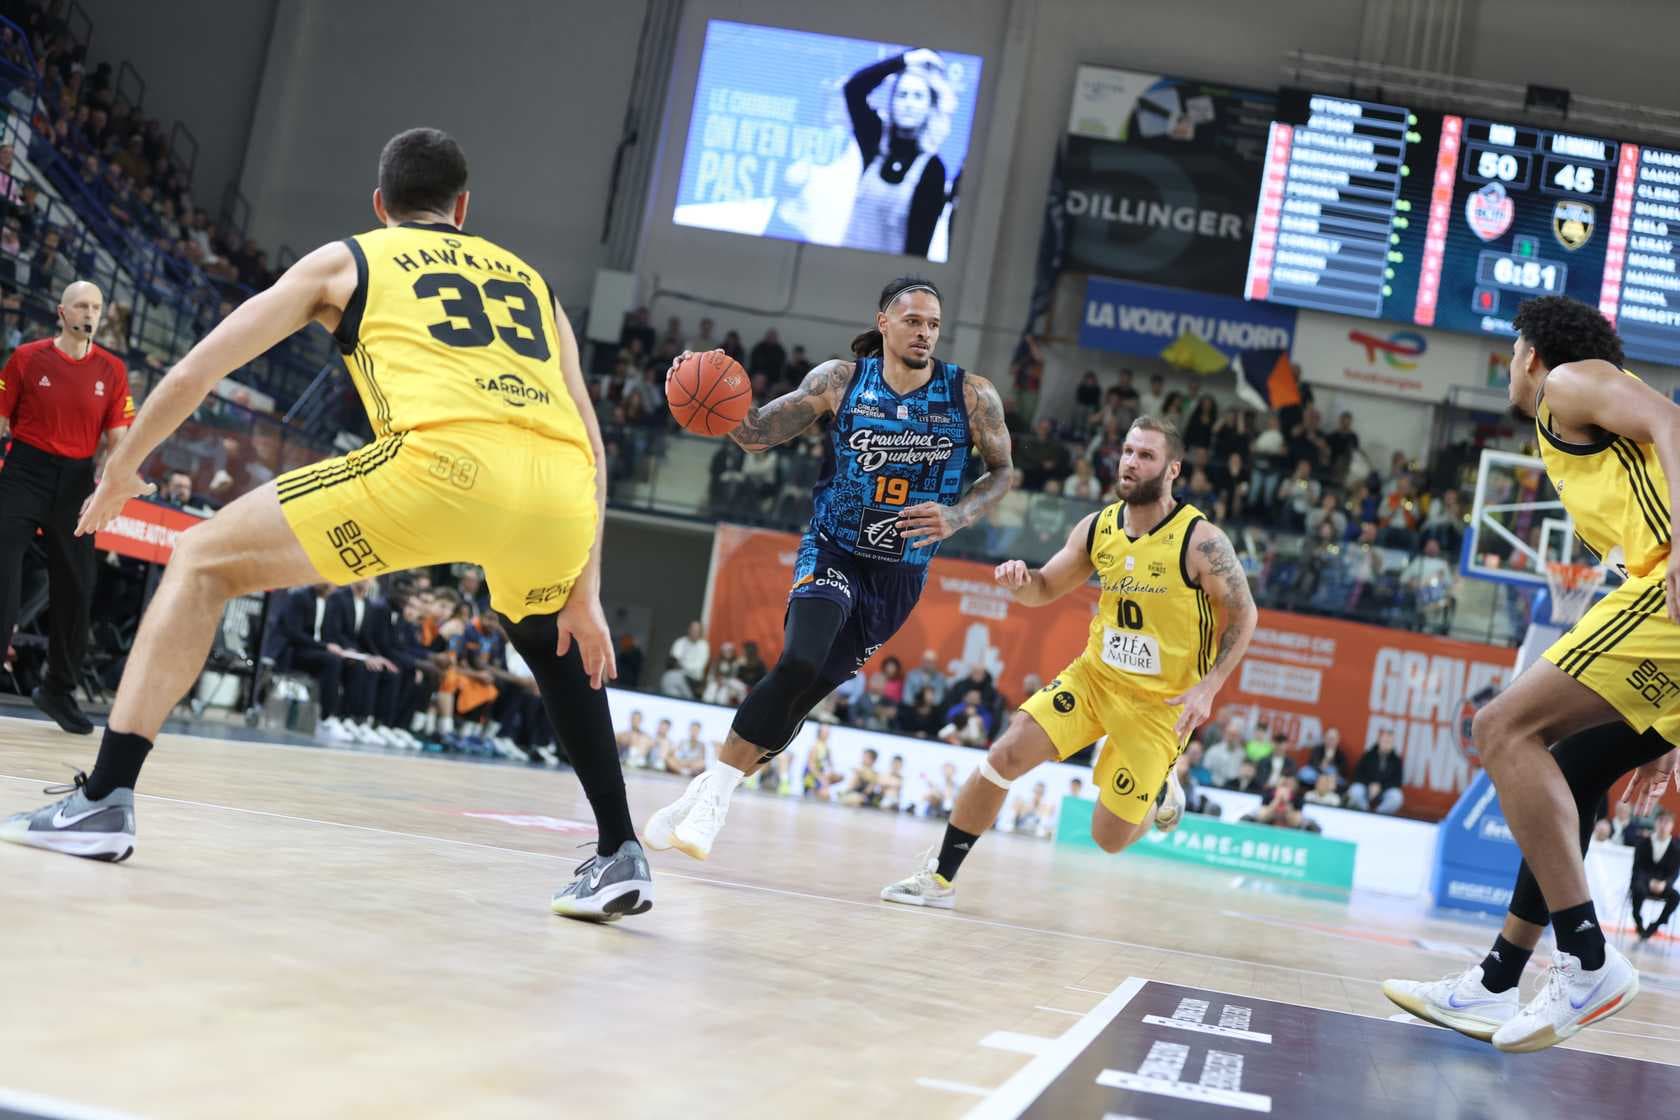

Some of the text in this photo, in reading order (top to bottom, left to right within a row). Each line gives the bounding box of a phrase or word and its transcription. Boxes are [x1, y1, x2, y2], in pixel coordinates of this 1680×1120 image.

[695, 151, 758, 201] PAS
[1478, 151, 1518, 181] 50
[1554, 163, 1595, 193] 45
[1065, 190, 1242, 240] DILLINGER
[412, 273, 552, 362] 33
[1086, 302, 1290, 349] LA VOIX DU NORD
[475, 378, 550, 405] SARRION
[848, 429, 935, 452] Gravelines
[428, 450, 479, 490] 33
[857, 446, 953, 472] Dunkerque
[874, 475, 910, 505] 19
[1117, 598, 1143, 631] 10
[1108, 649, 1153, 669] NATURE
[1122, 635, 1152, 657] LÉA
[1625, 669, 1665, 709] SOL
[1174, 830, 1308, 866] PARE-BRISE
